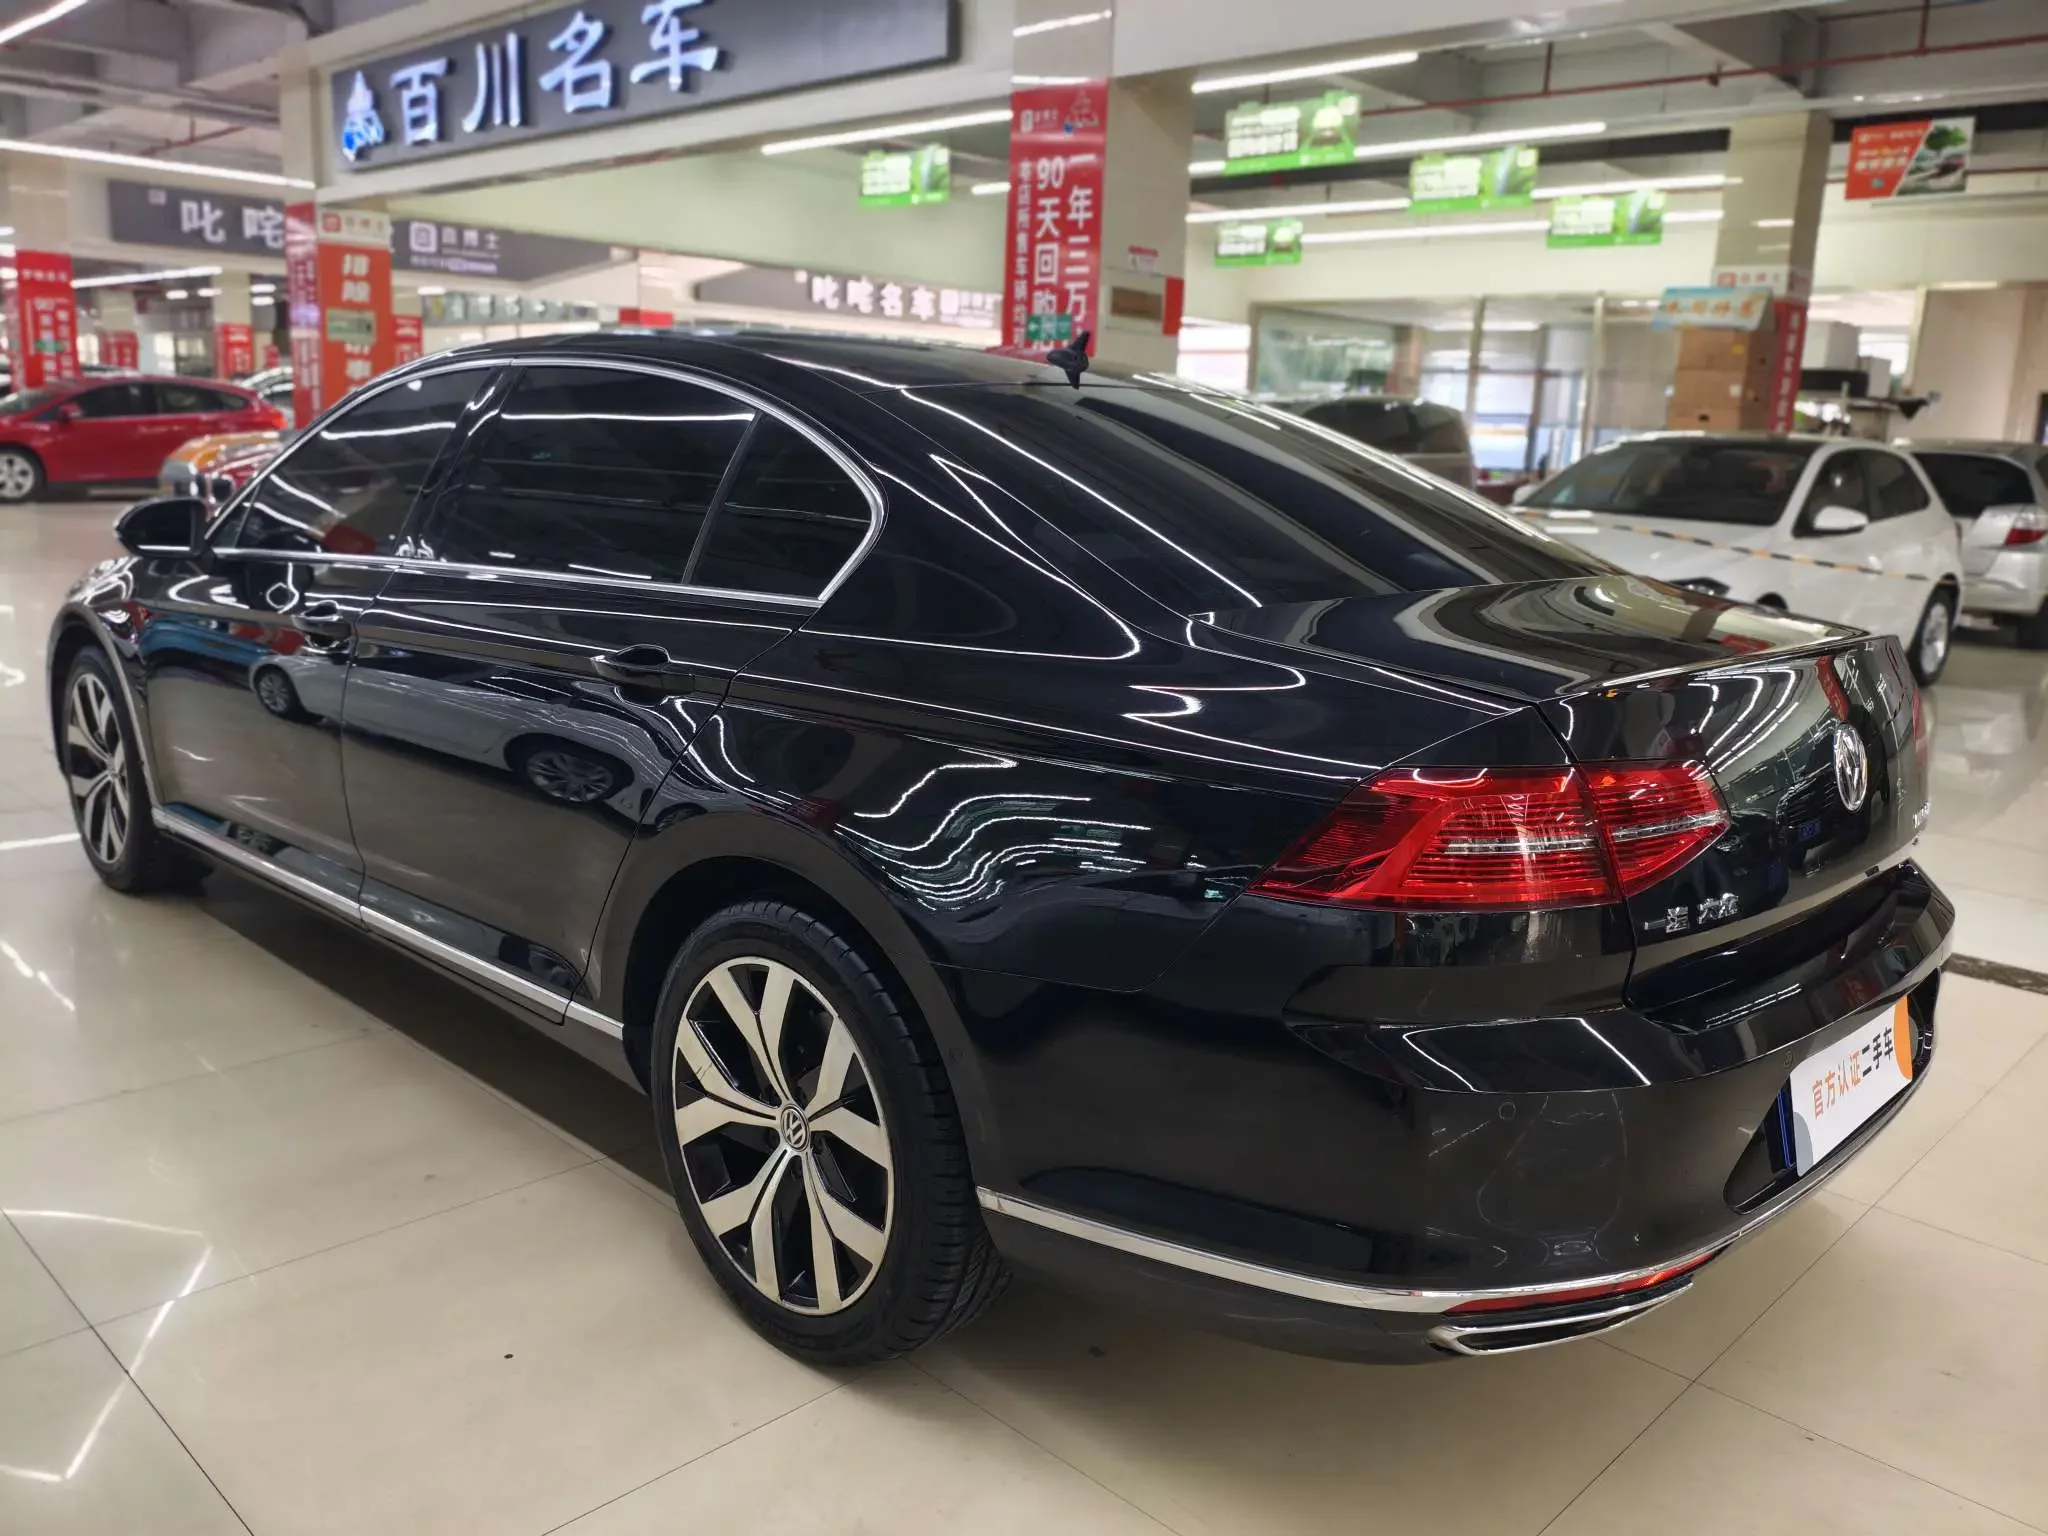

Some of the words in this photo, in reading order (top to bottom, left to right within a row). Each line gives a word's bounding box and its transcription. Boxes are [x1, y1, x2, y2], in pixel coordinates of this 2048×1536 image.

[390, 0, 718, 147] 百川名车
[812, 275, 936, 321] 叱咤名车
[1062, 154, 1097, 346] 一年三万
[1812, 1027, 1894, 1120] 官方认证二手车
